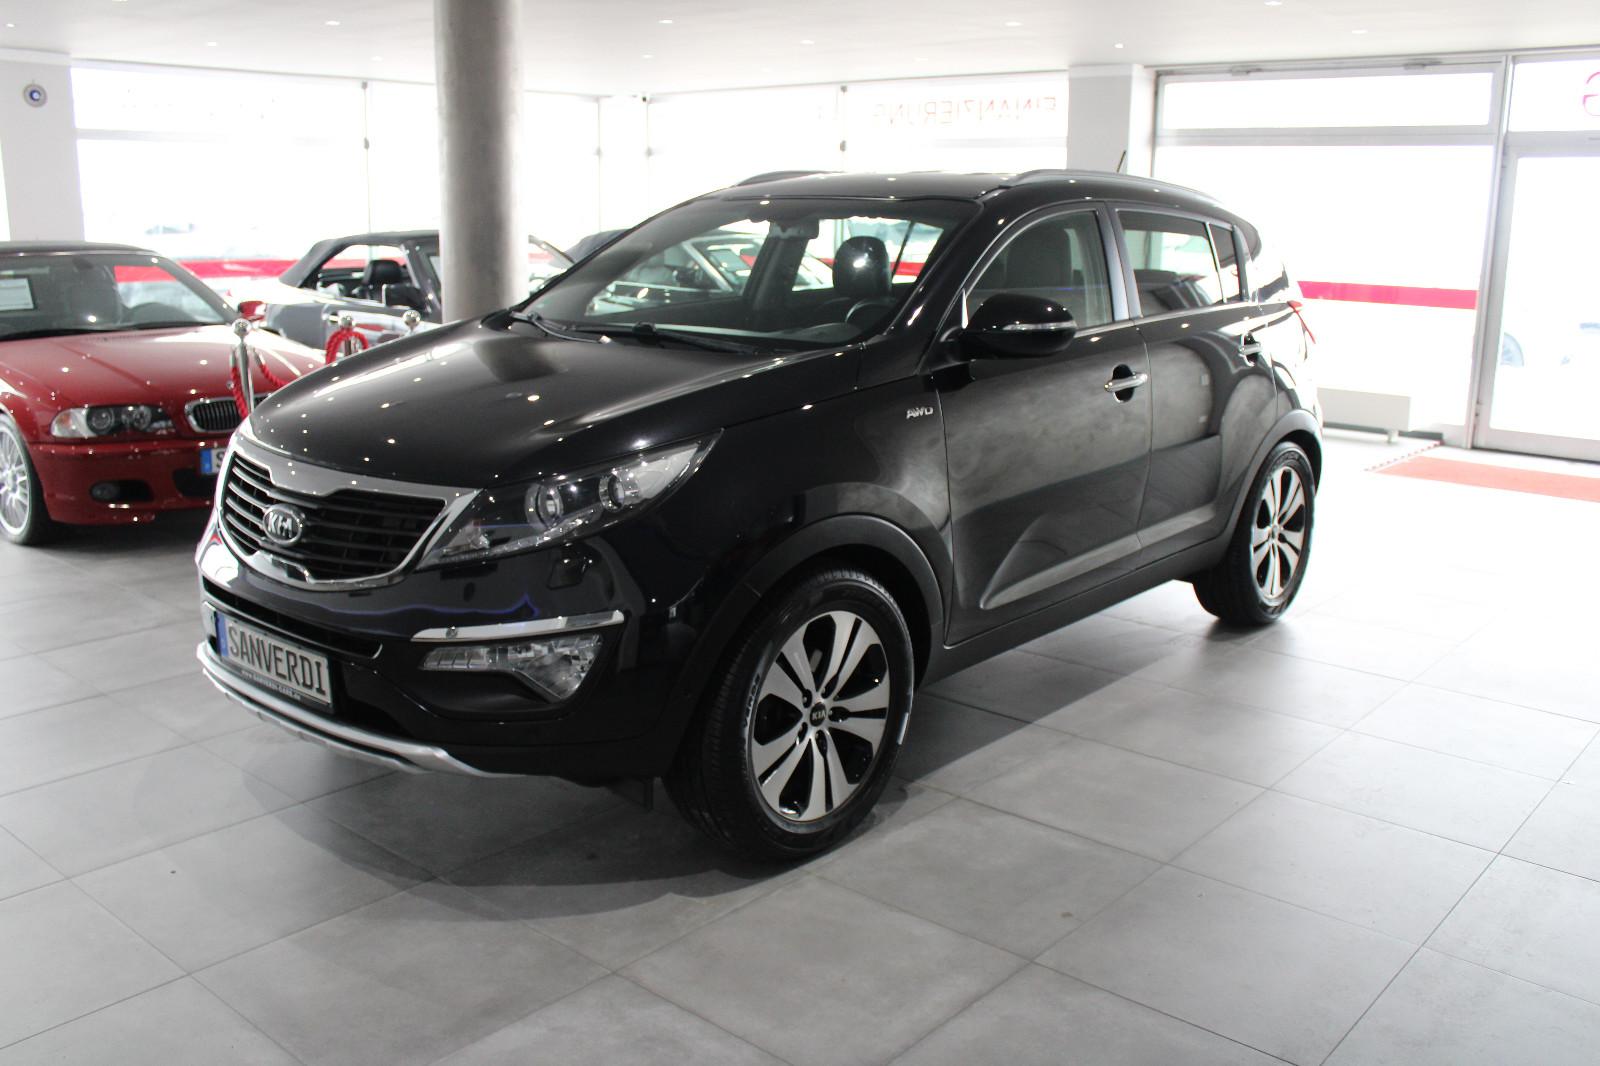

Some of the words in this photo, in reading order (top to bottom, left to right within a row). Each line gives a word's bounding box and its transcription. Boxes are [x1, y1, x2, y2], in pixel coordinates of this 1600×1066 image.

[906, 406, 933, 419] AWD
[268, 512, 293, 538] KIA
[228, 626, 326, 696] SANVERDI
[812, 710, 826, 720] KIA
